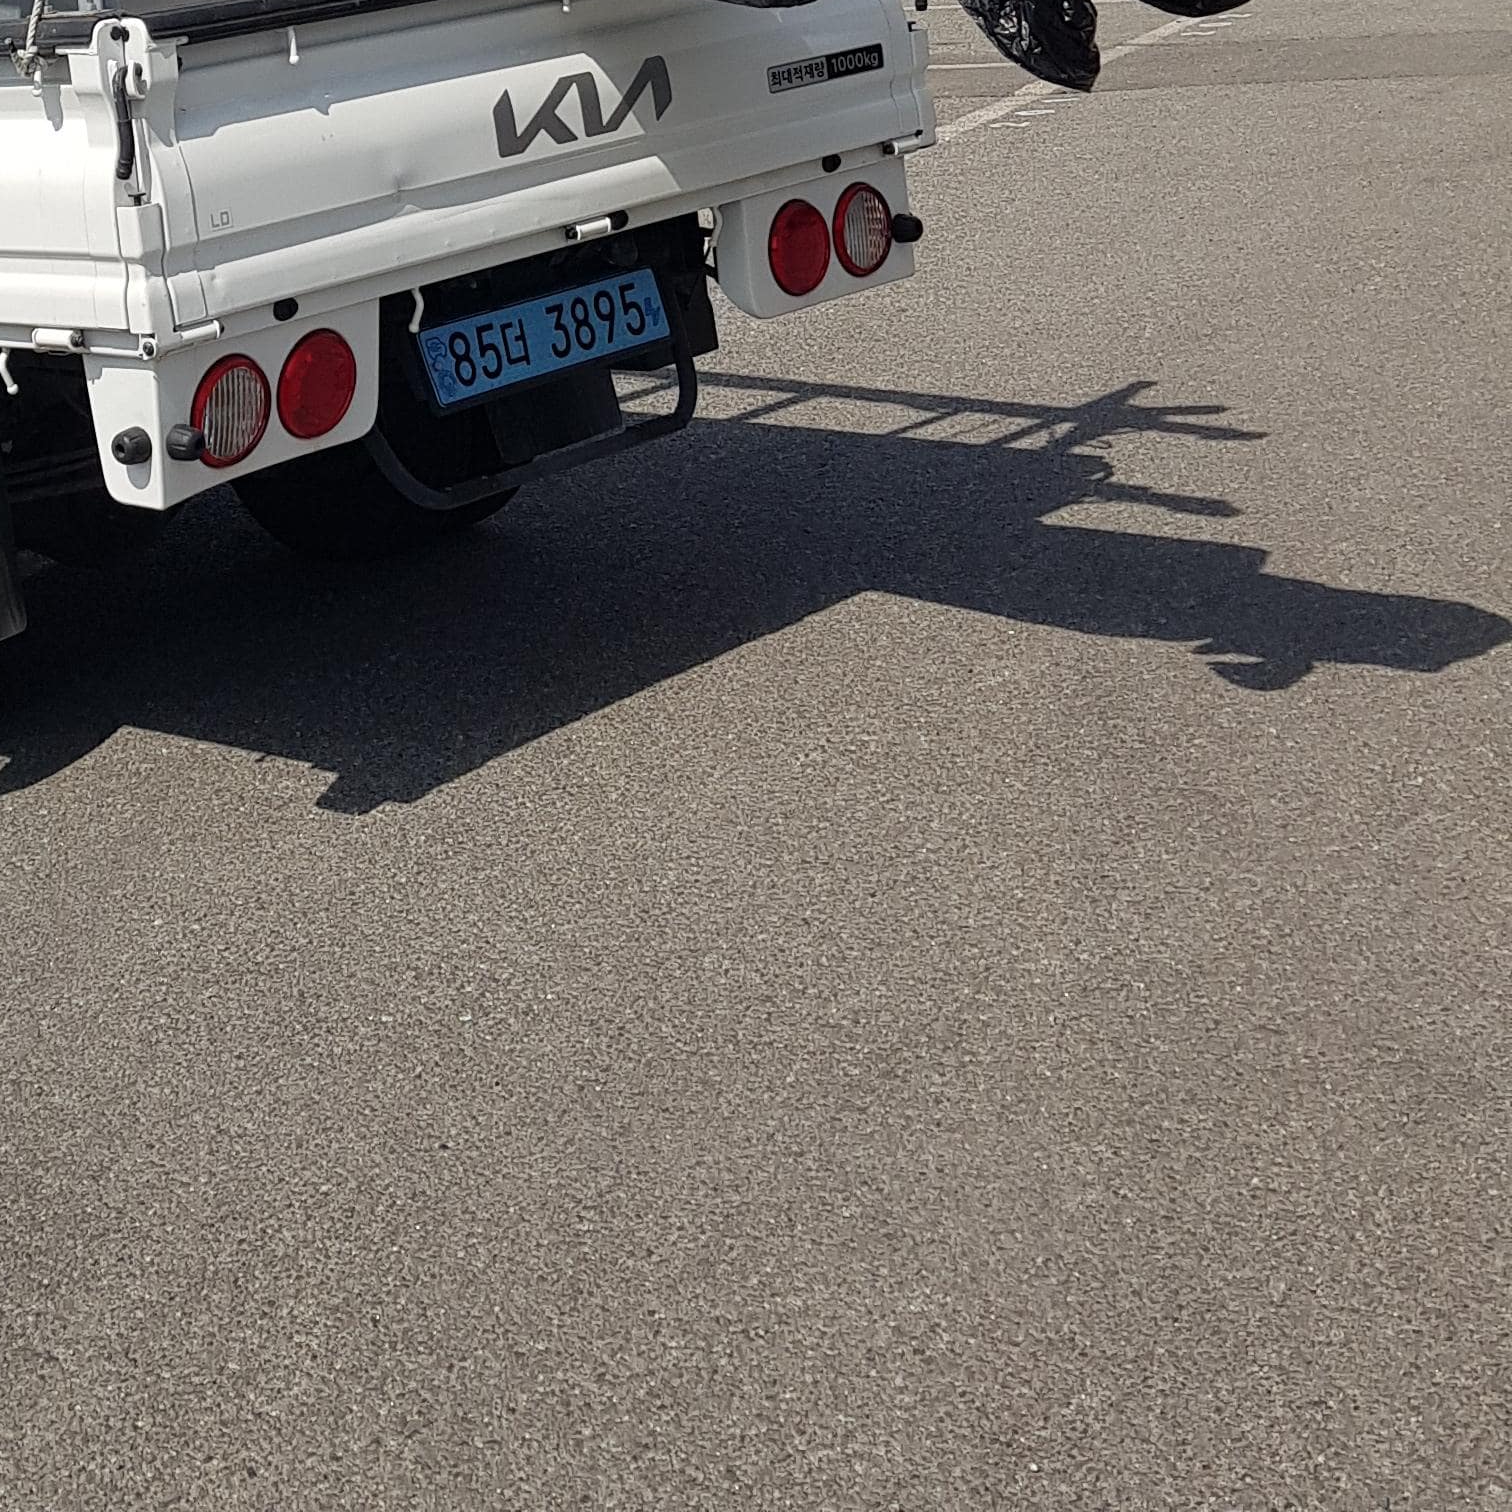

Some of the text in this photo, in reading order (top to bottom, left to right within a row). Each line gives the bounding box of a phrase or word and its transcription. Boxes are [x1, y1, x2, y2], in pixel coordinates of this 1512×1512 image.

[492, 55, 673, 159] KIA
[770, 50, 879, 87] 최대적재량 1000kg
[448, 282, 646, 387] 85더 3895
